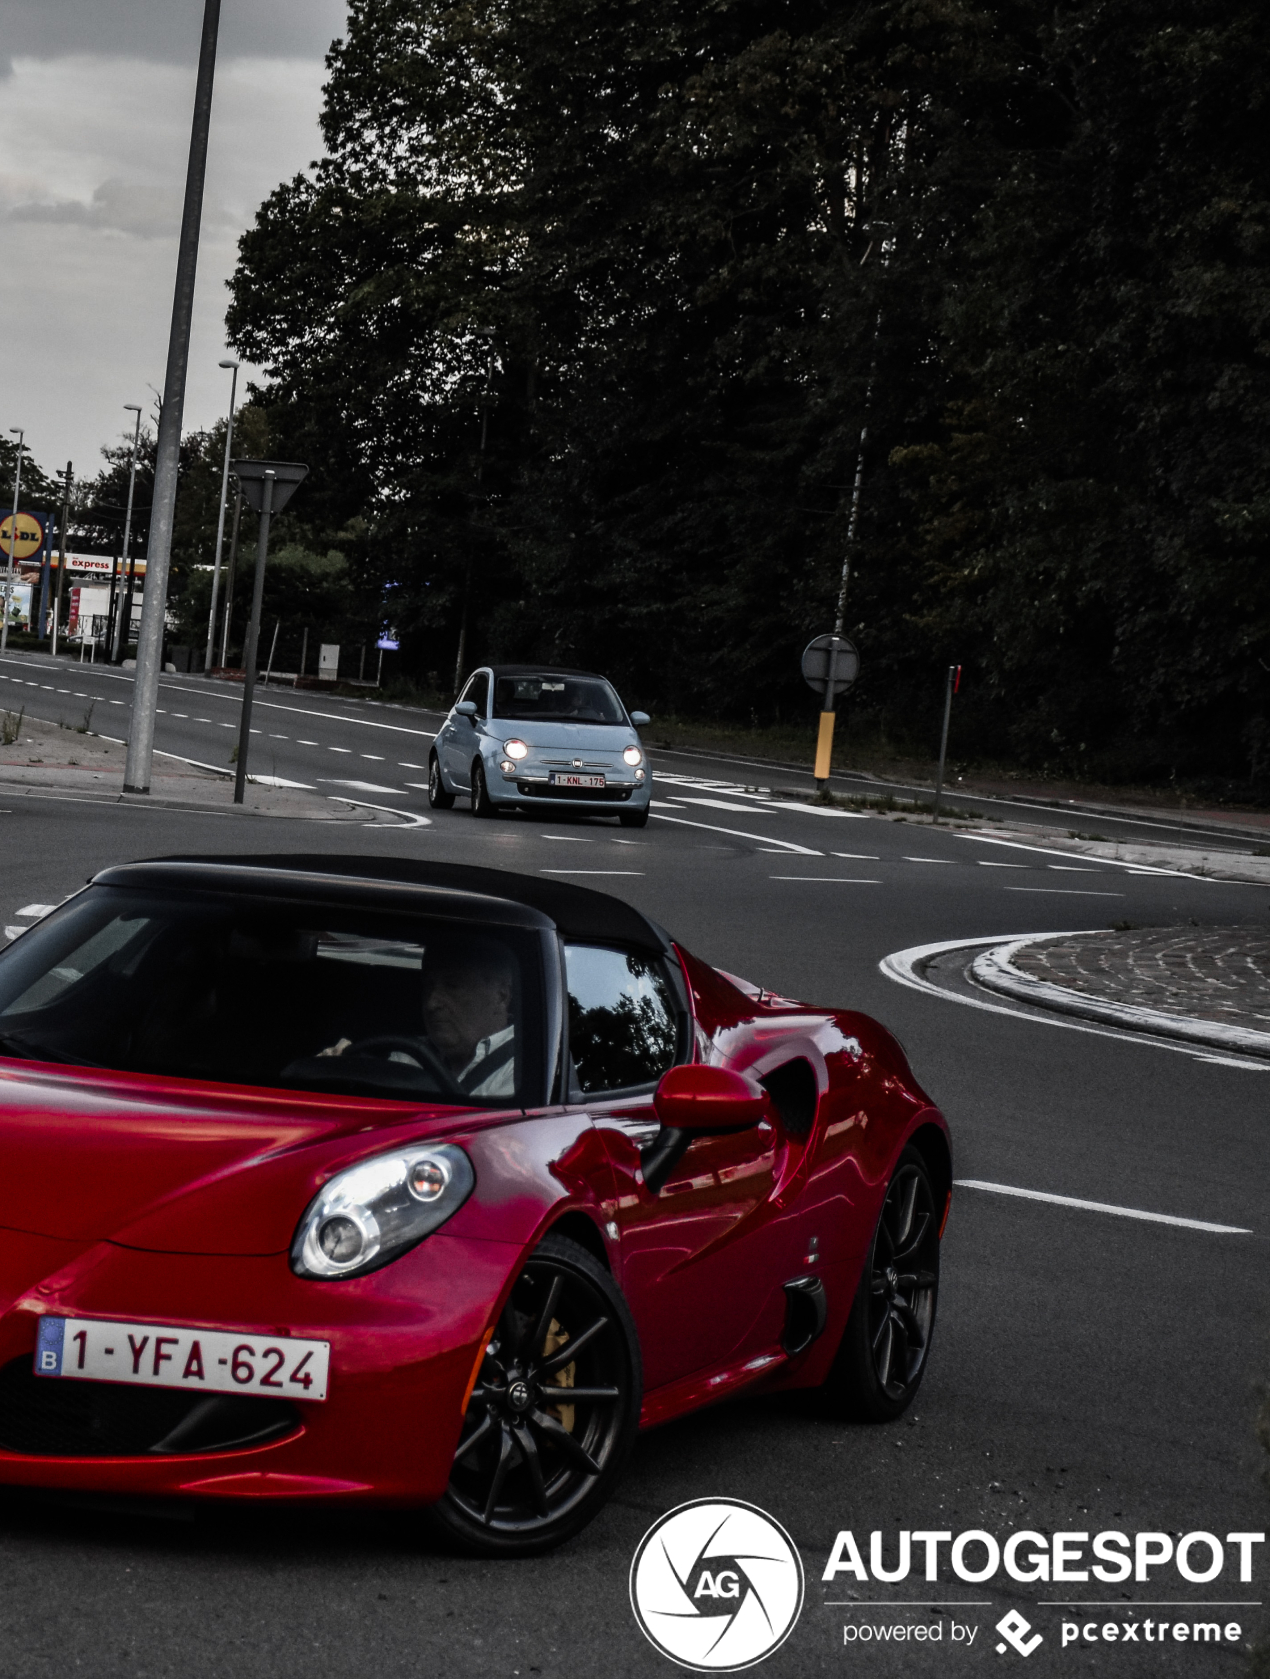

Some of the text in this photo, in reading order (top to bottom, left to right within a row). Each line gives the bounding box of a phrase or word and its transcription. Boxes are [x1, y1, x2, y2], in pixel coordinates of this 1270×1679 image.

[71, 559, 110, 569] express
[558, 776, 605, 786] 1-KNL-175
[41, 1350, 57, 1371] B
[72, 1329, 315, 1390] 1-YFA-624
